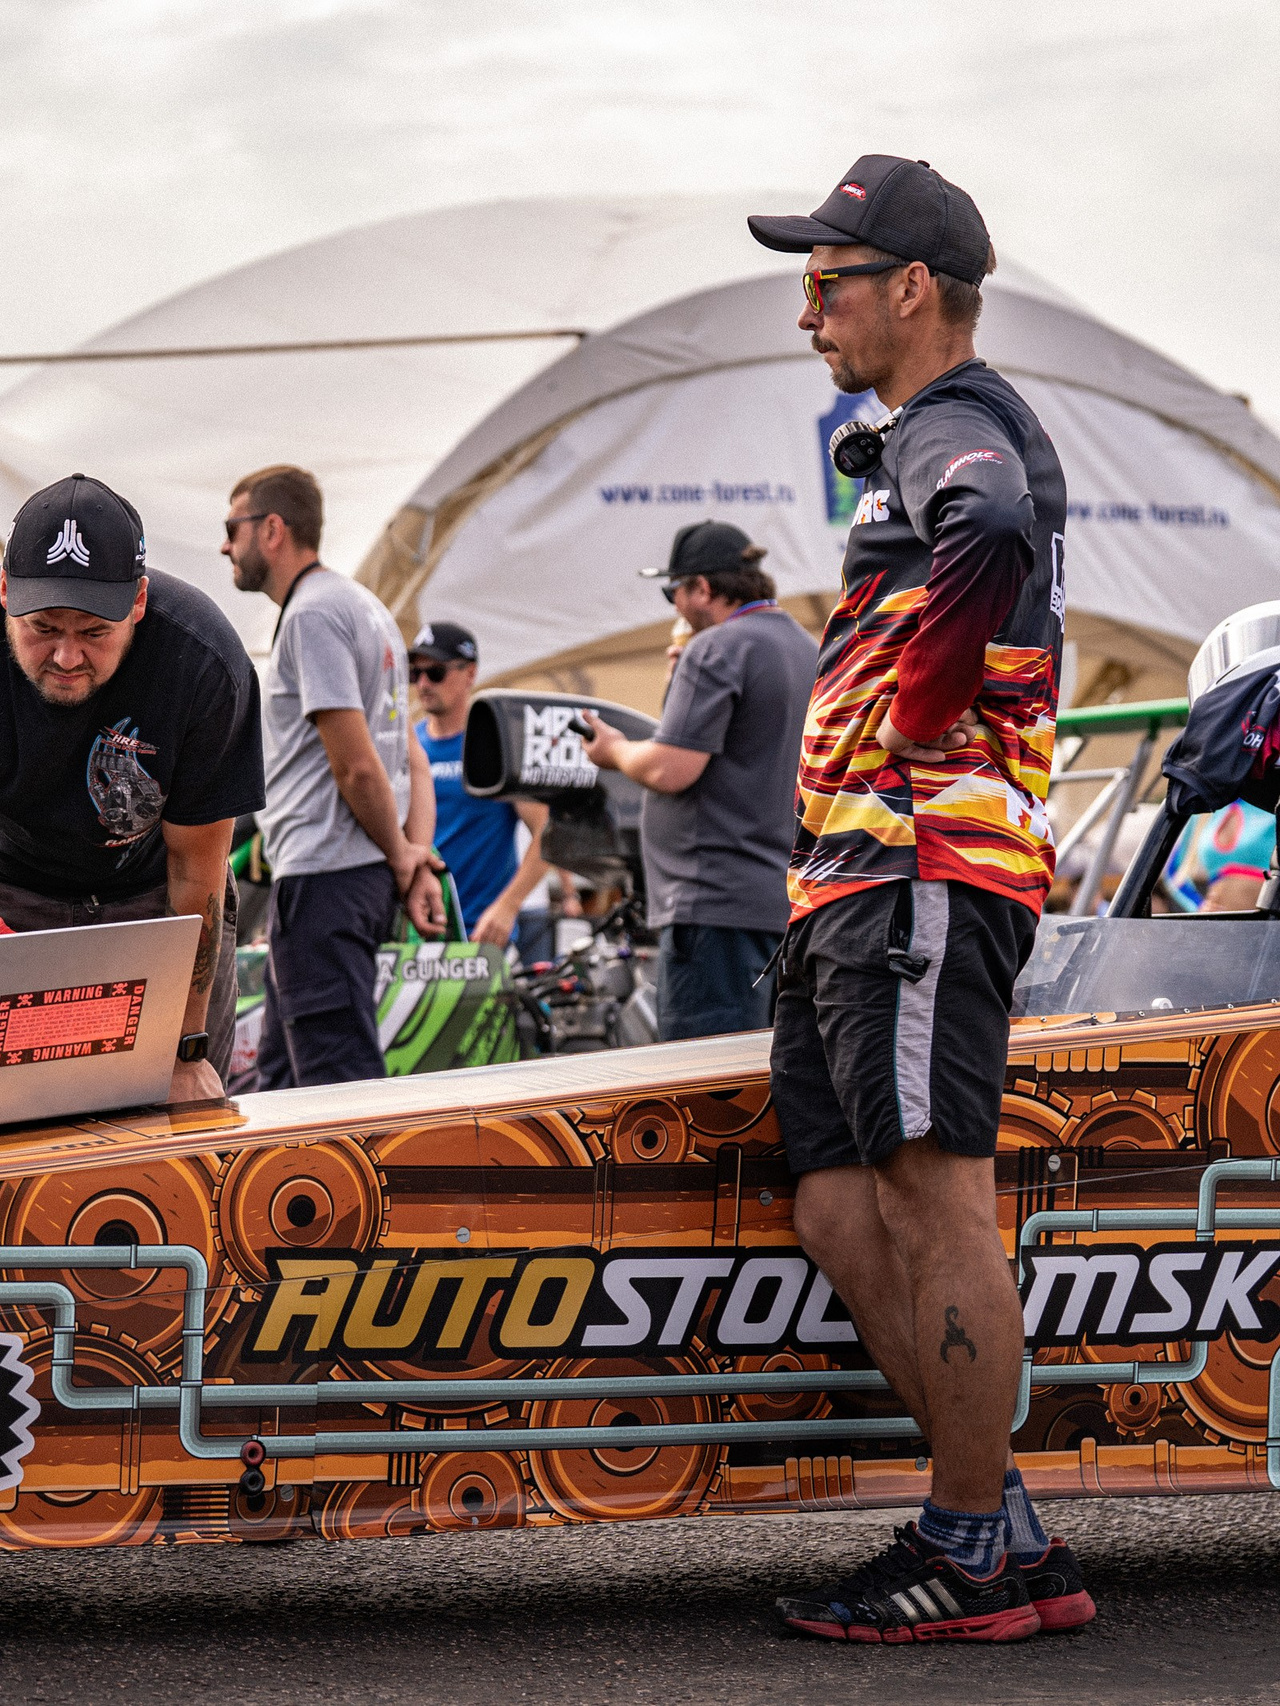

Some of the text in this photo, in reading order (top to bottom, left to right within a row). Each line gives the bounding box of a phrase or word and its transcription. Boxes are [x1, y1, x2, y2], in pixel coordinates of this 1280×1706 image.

[43, 985, 104, 1004] WARNING
[123, 984, 145, 1046] DANGER
[32, 1042, 92, 1062] WARNING
[1023, 1250, 1280, 1338] MSK
